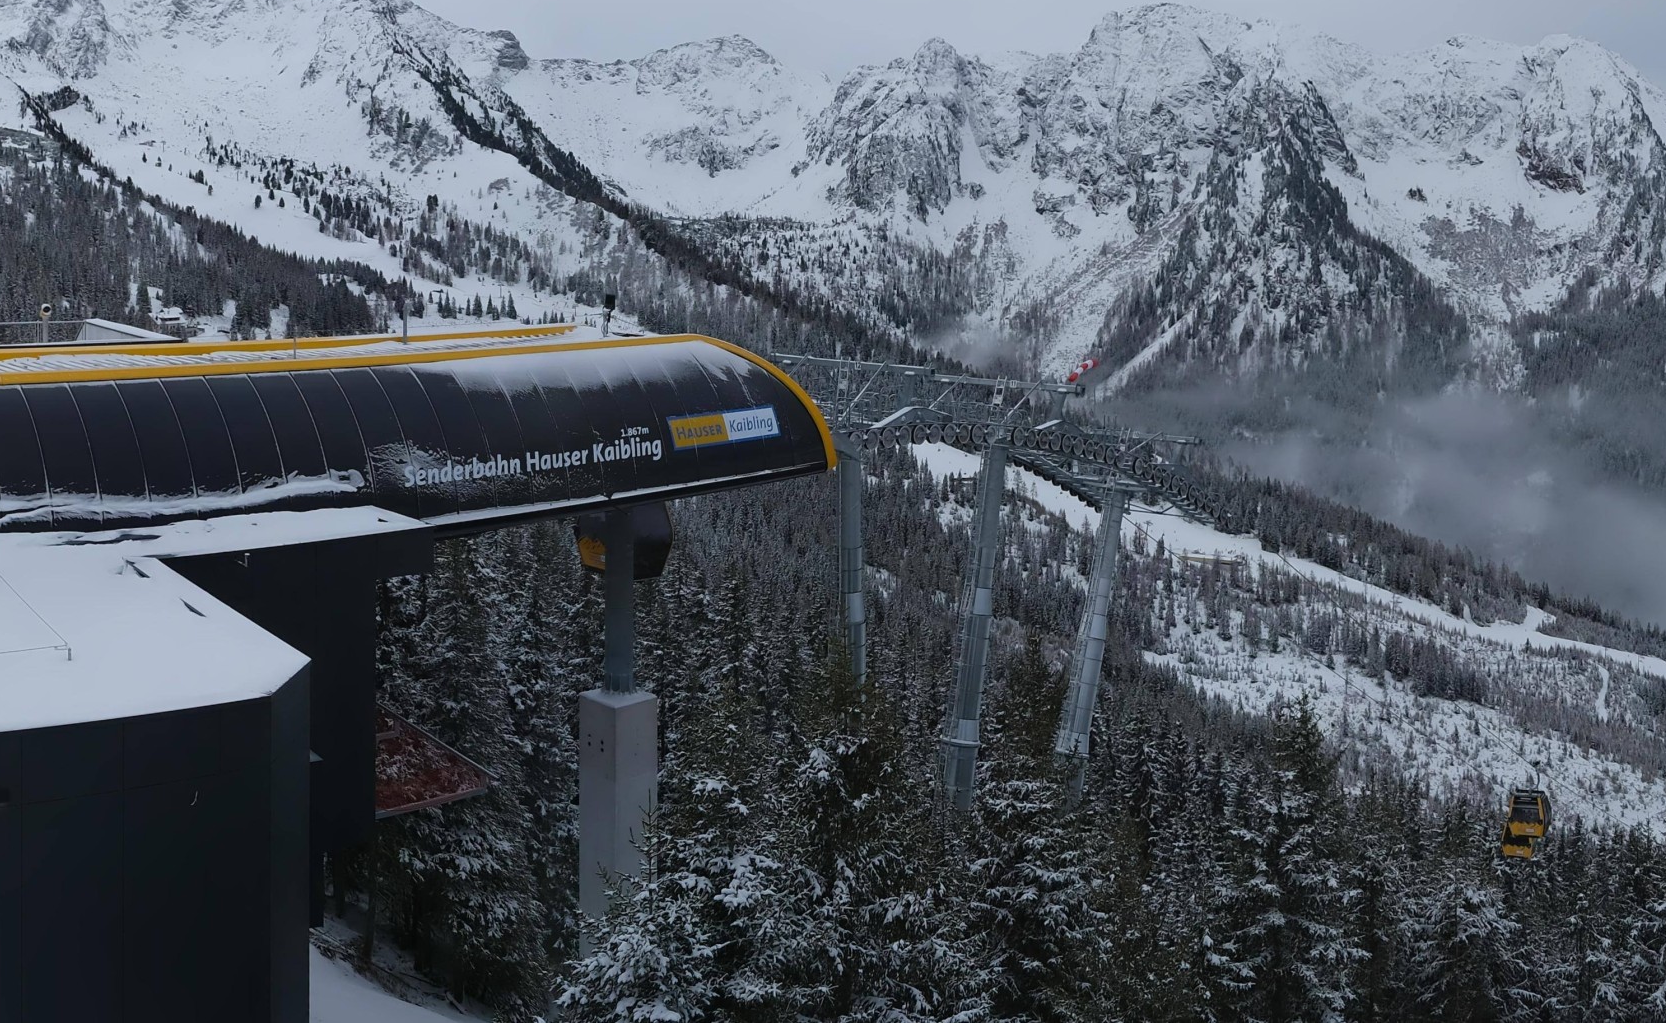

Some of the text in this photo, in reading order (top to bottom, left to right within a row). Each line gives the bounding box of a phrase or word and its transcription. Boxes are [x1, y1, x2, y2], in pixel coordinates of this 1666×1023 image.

[620, 427, 649, 437] 1.867m
[676, 416, 773, 440] HAUSER Kaibling
[404, 436, 662, 488] Senderbahn Hauser Kaibling
